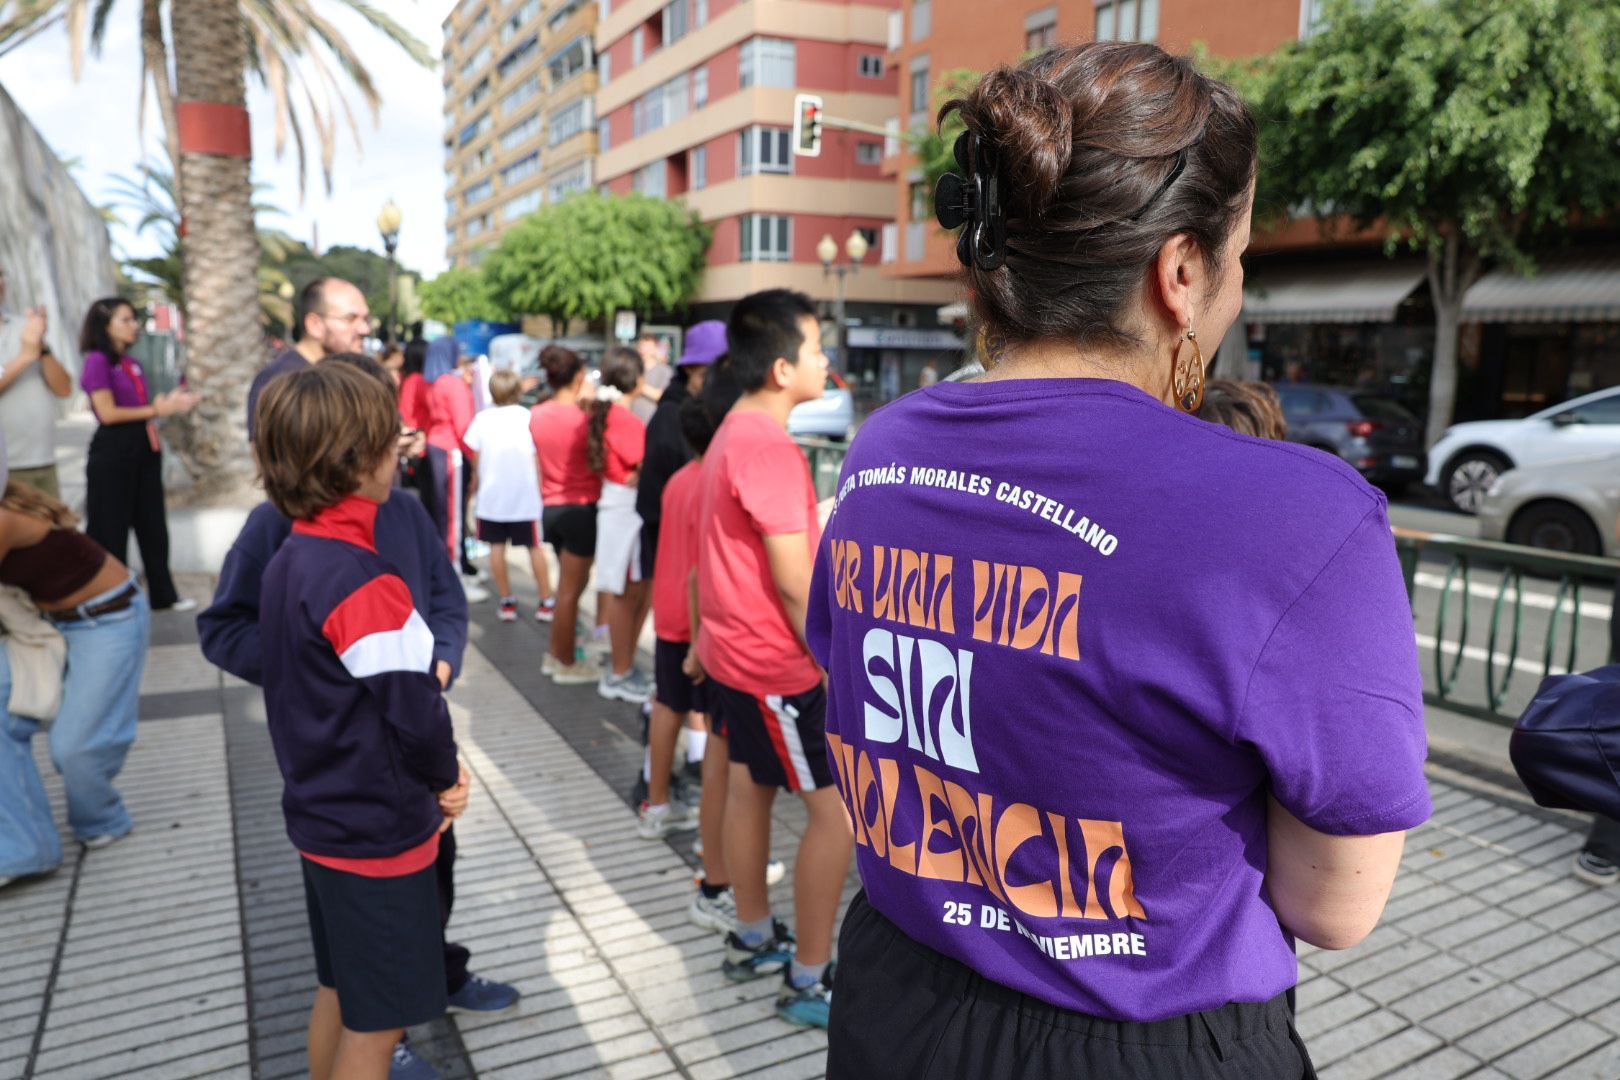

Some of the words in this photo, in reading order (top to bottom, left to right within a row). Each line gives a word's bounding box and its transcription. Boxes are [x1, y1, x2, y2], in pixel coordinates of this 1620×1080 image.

[858, 462, 906, 487] TOMÁS
[910, 467, 992, 496] MORALES
[995, 482, 1119, 556] CASTELLANO
[873, 545, 955, 634] UNA
[972, 559, 1083, 661] VIDA
[863, 628, 980, 774] SIN
[942, 901, 972, 926] 25
[981, 907, 1011, 932] DE
[1013, 917, 1147, 960] NVIEMBRE
